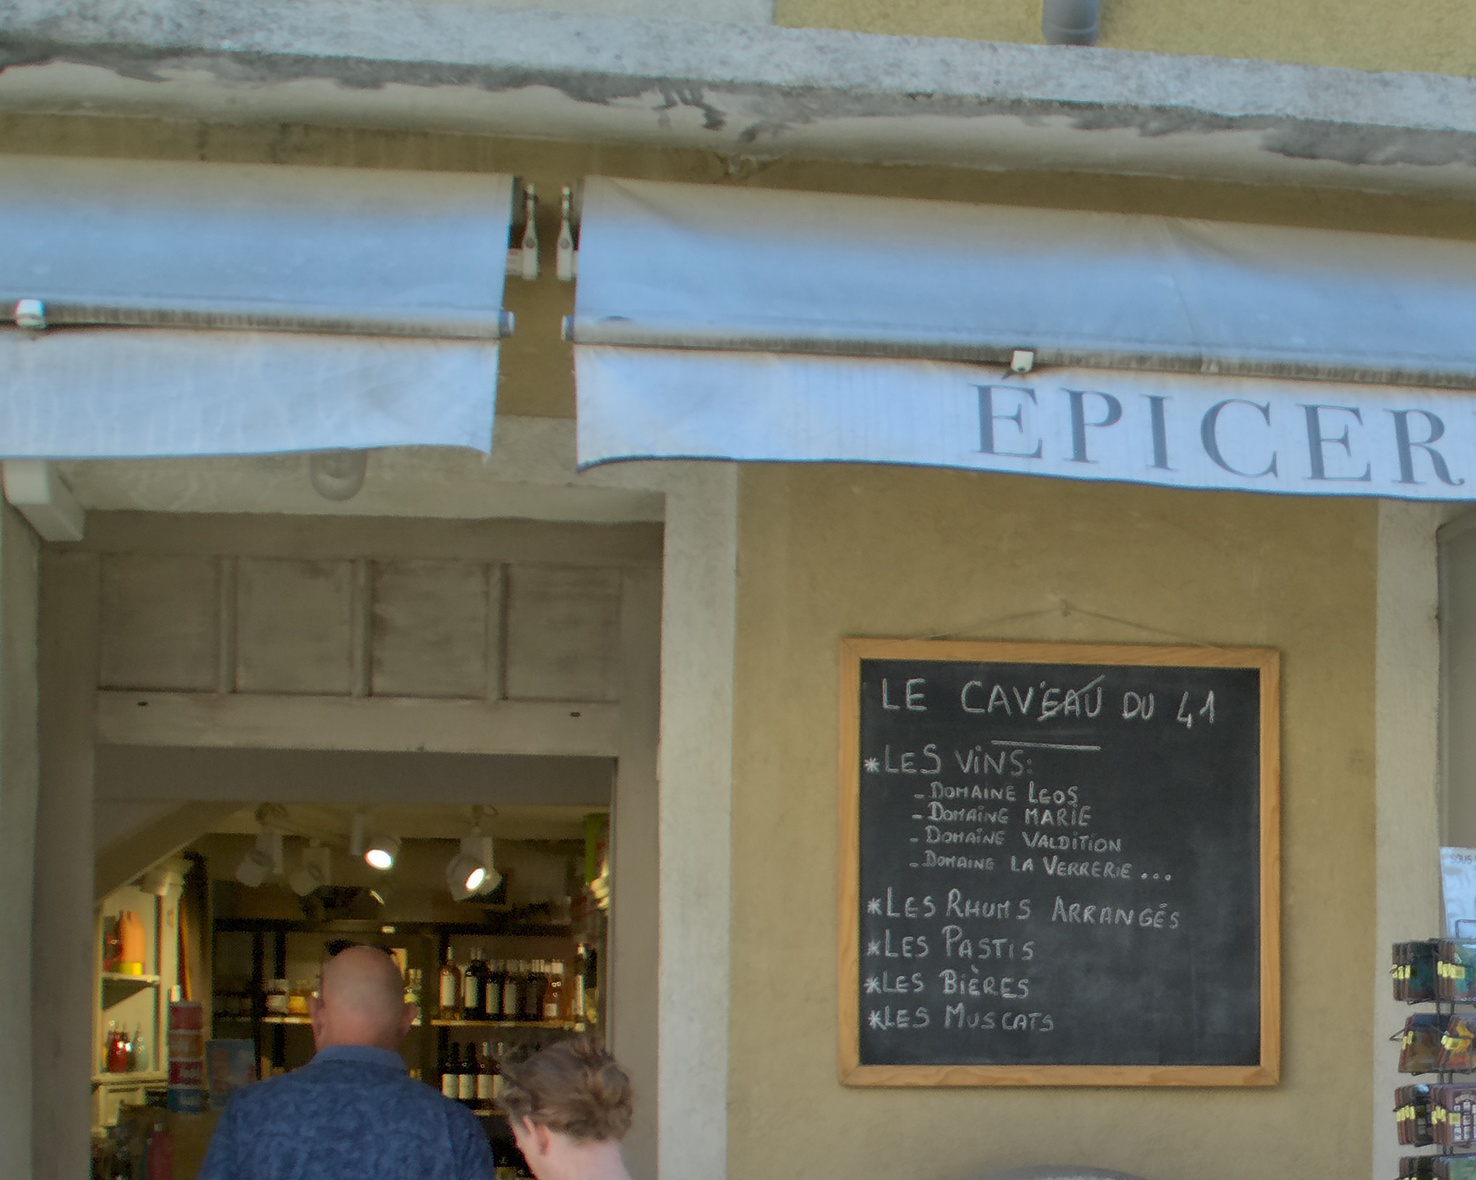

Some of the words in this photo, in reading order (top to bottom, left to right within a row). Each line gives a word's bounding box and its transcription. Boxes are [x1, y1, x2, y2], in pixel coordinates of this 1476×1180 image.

[881, 677, 929, 714] LE
[1122, 691, 1155, 720] DU
[1176, 688, 1216, 729] 41
[883, 743, 942, 775] LES
[1027, 780, 1080, 805] LEOS
[1010, 855, 1035, 873] LA
[886, 886, 938, 919] LES
[884, 929, 930, 959] LES
[882, 966, 926, 994] LES
[882, 1002, 931, 1030] LES
